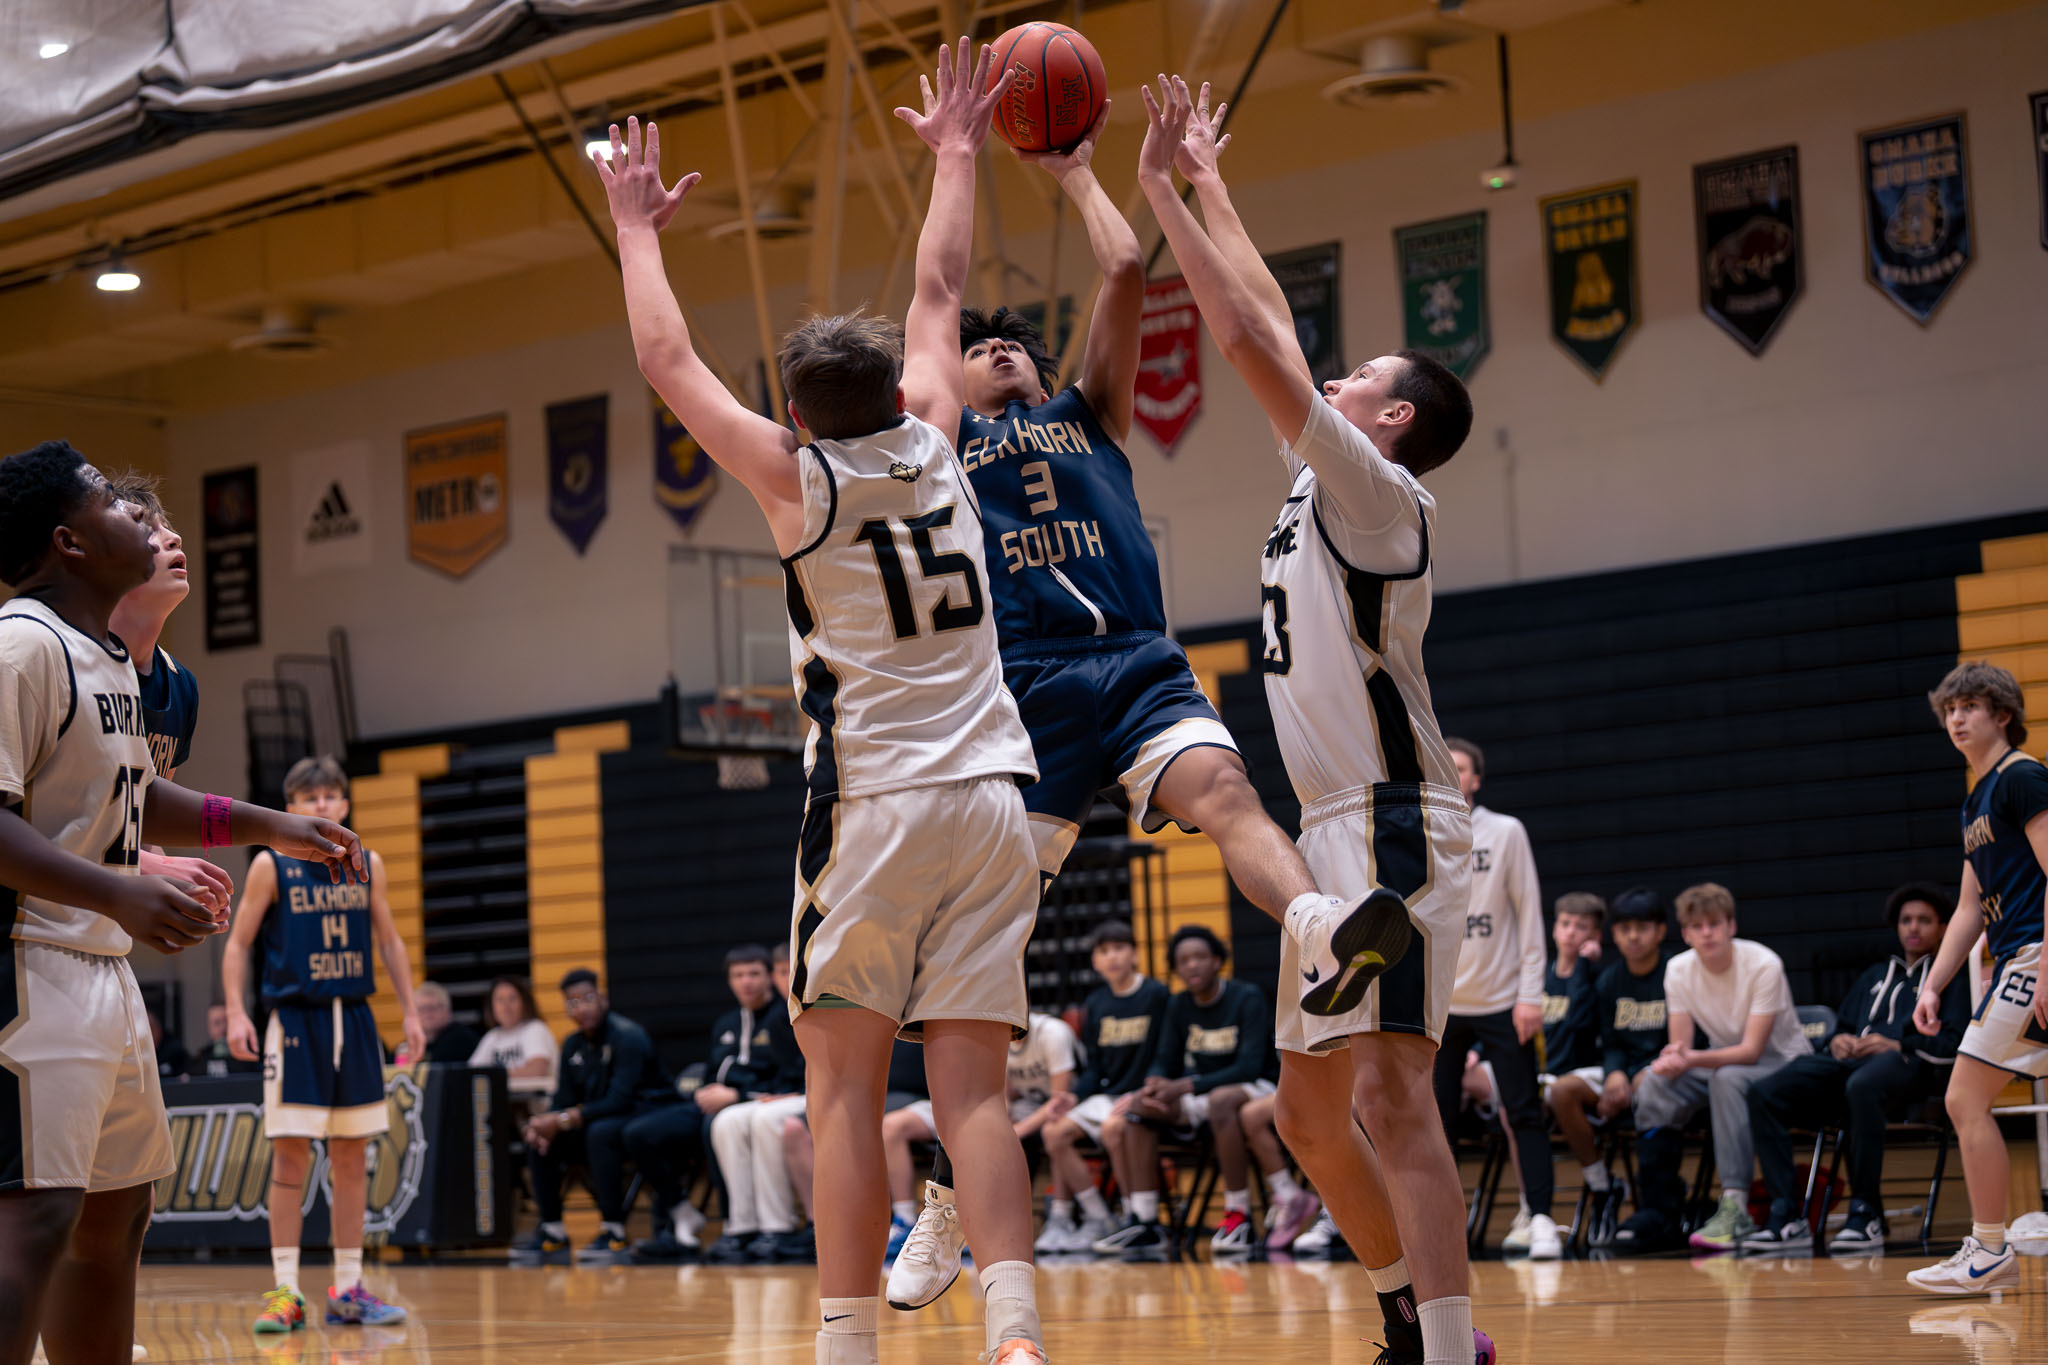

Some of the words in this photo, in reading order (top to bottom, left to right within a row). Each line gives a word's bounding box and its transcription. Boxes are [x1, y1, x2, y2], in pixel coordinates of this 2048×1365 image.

[963, 416, 1093, 474] ELKHORN
[1021, 460, 1059, 517] 3
[848, 501, 985, 643] 15
[1000, 519, 1106, 575] SOUTH
[101, 763, 147, 866] 25
[288, 883, 370, 914] ELKHORN
[322, 913, 350, 950] 14
[309, 951, 364, 981] SOUTH
[2000, 972, 2039, 1008] ES
